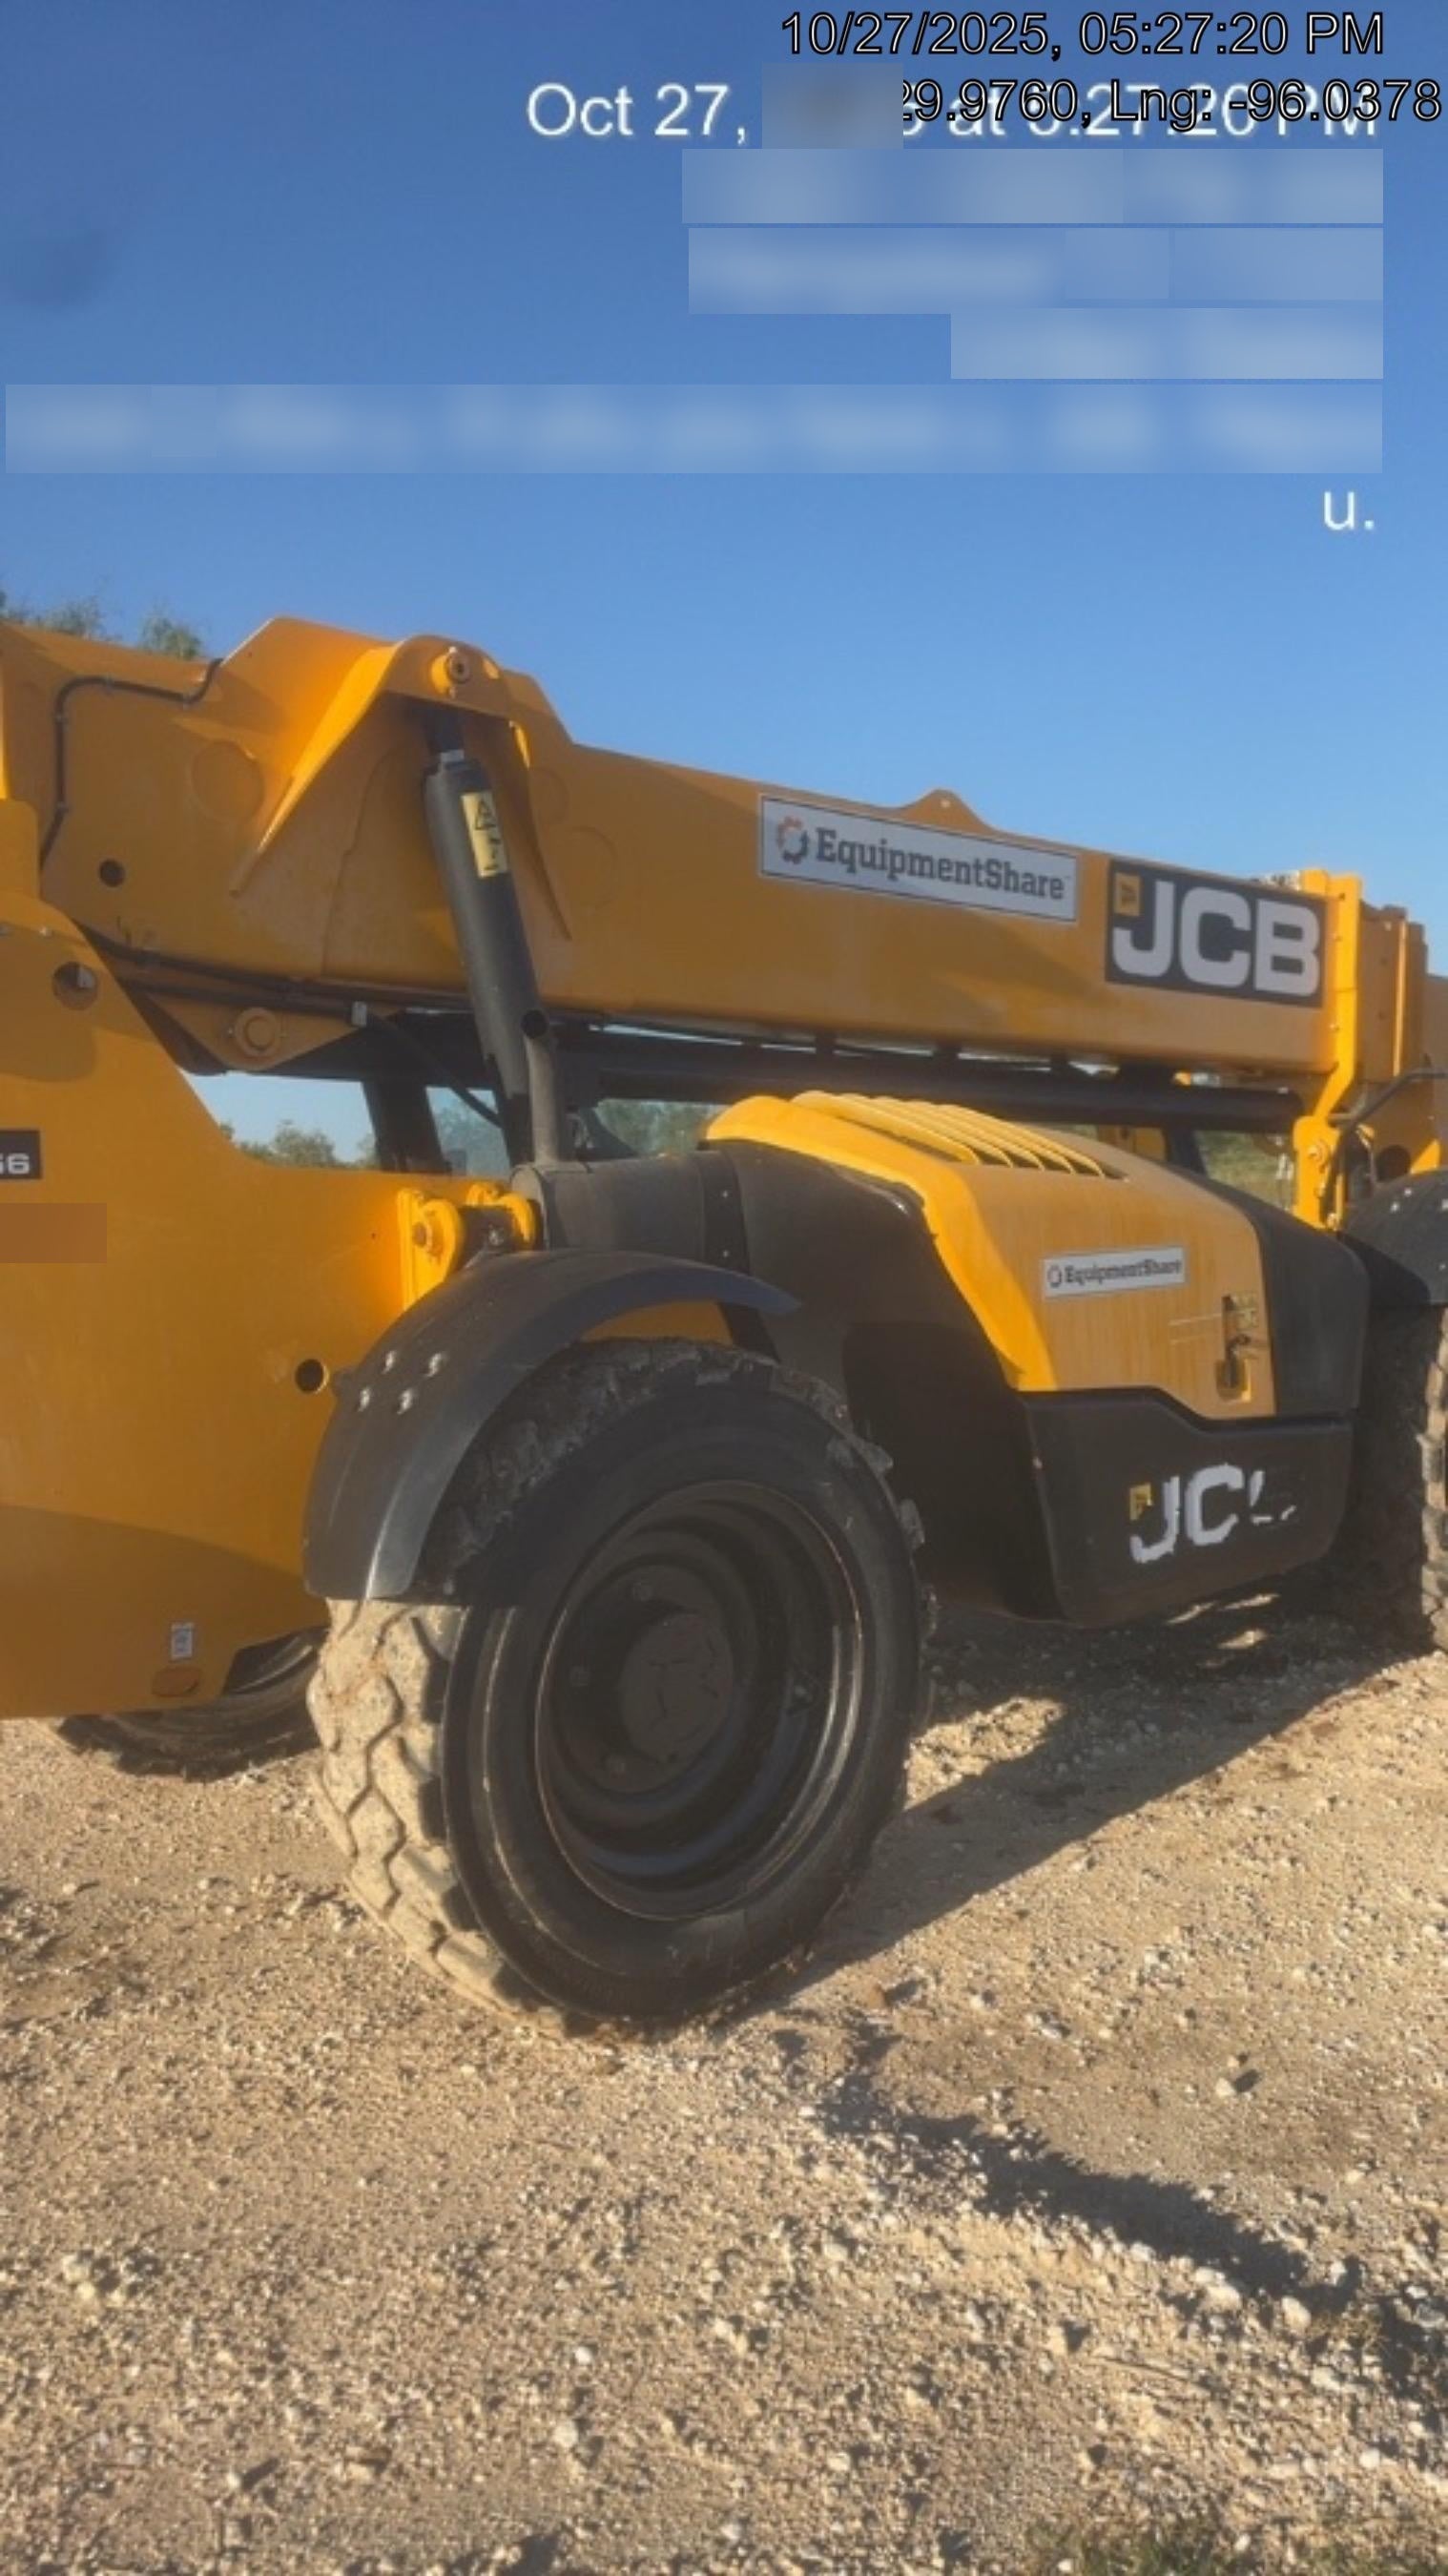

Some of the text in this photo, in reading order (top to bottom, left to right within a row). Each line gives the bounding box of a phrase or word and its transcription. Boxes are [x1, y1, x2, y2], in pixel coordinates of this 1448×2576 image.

[816, 827, 1065, 900] EquipmentShare
[1112, 879, 1320, 996] JCB
[0, 1153, 30, 1174] 6
